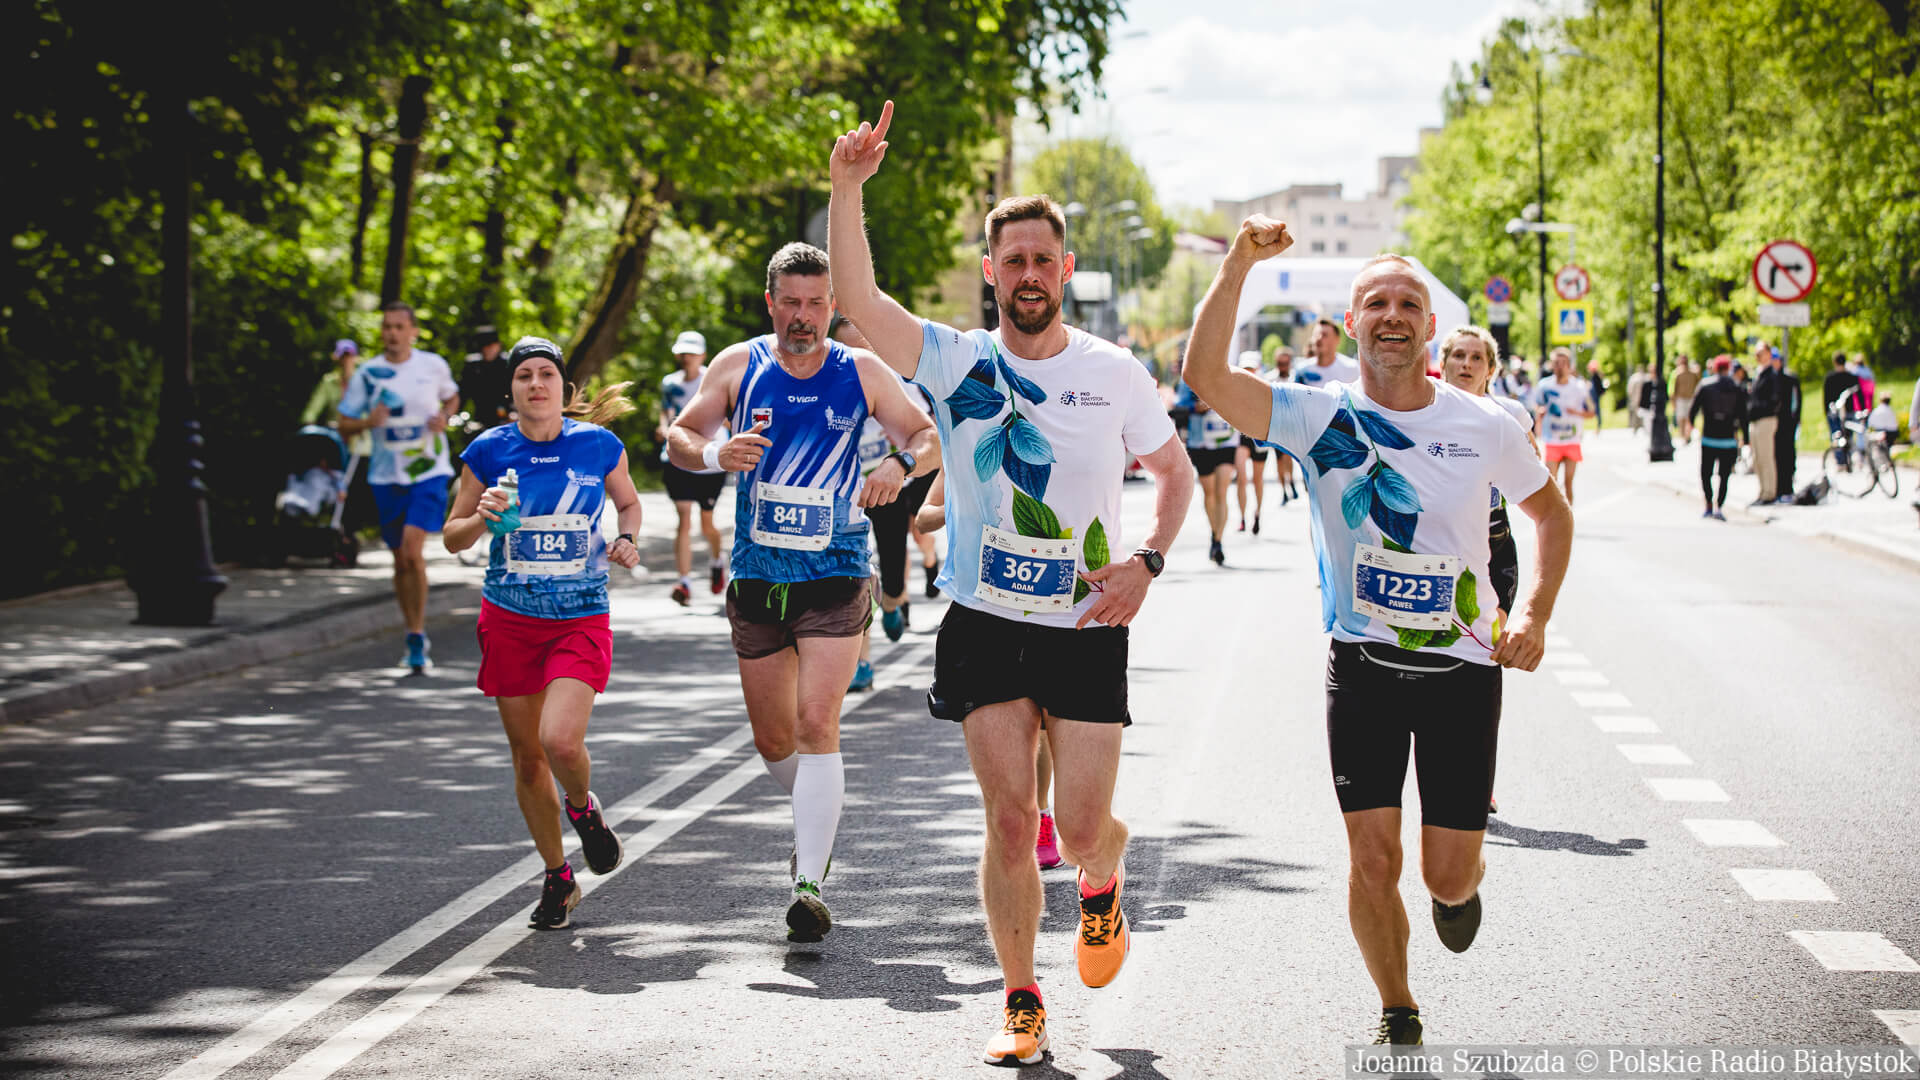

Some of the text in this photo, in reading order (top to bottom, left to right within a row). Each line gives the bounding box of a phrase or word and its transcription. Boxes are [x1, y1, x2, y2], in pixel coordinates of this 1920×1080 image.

[773, 505, 808, 527] 841
[778, 525, 803, 534] JANUSZ
[532, 533, 568, 552] 184
[1003, 556, 1048, 583] 367
[1011, 582, 1035, 593] ADAM
[1376, 573, 1433, 602] 1223
[1388, 599, 1414, 610] PAWEŁ
